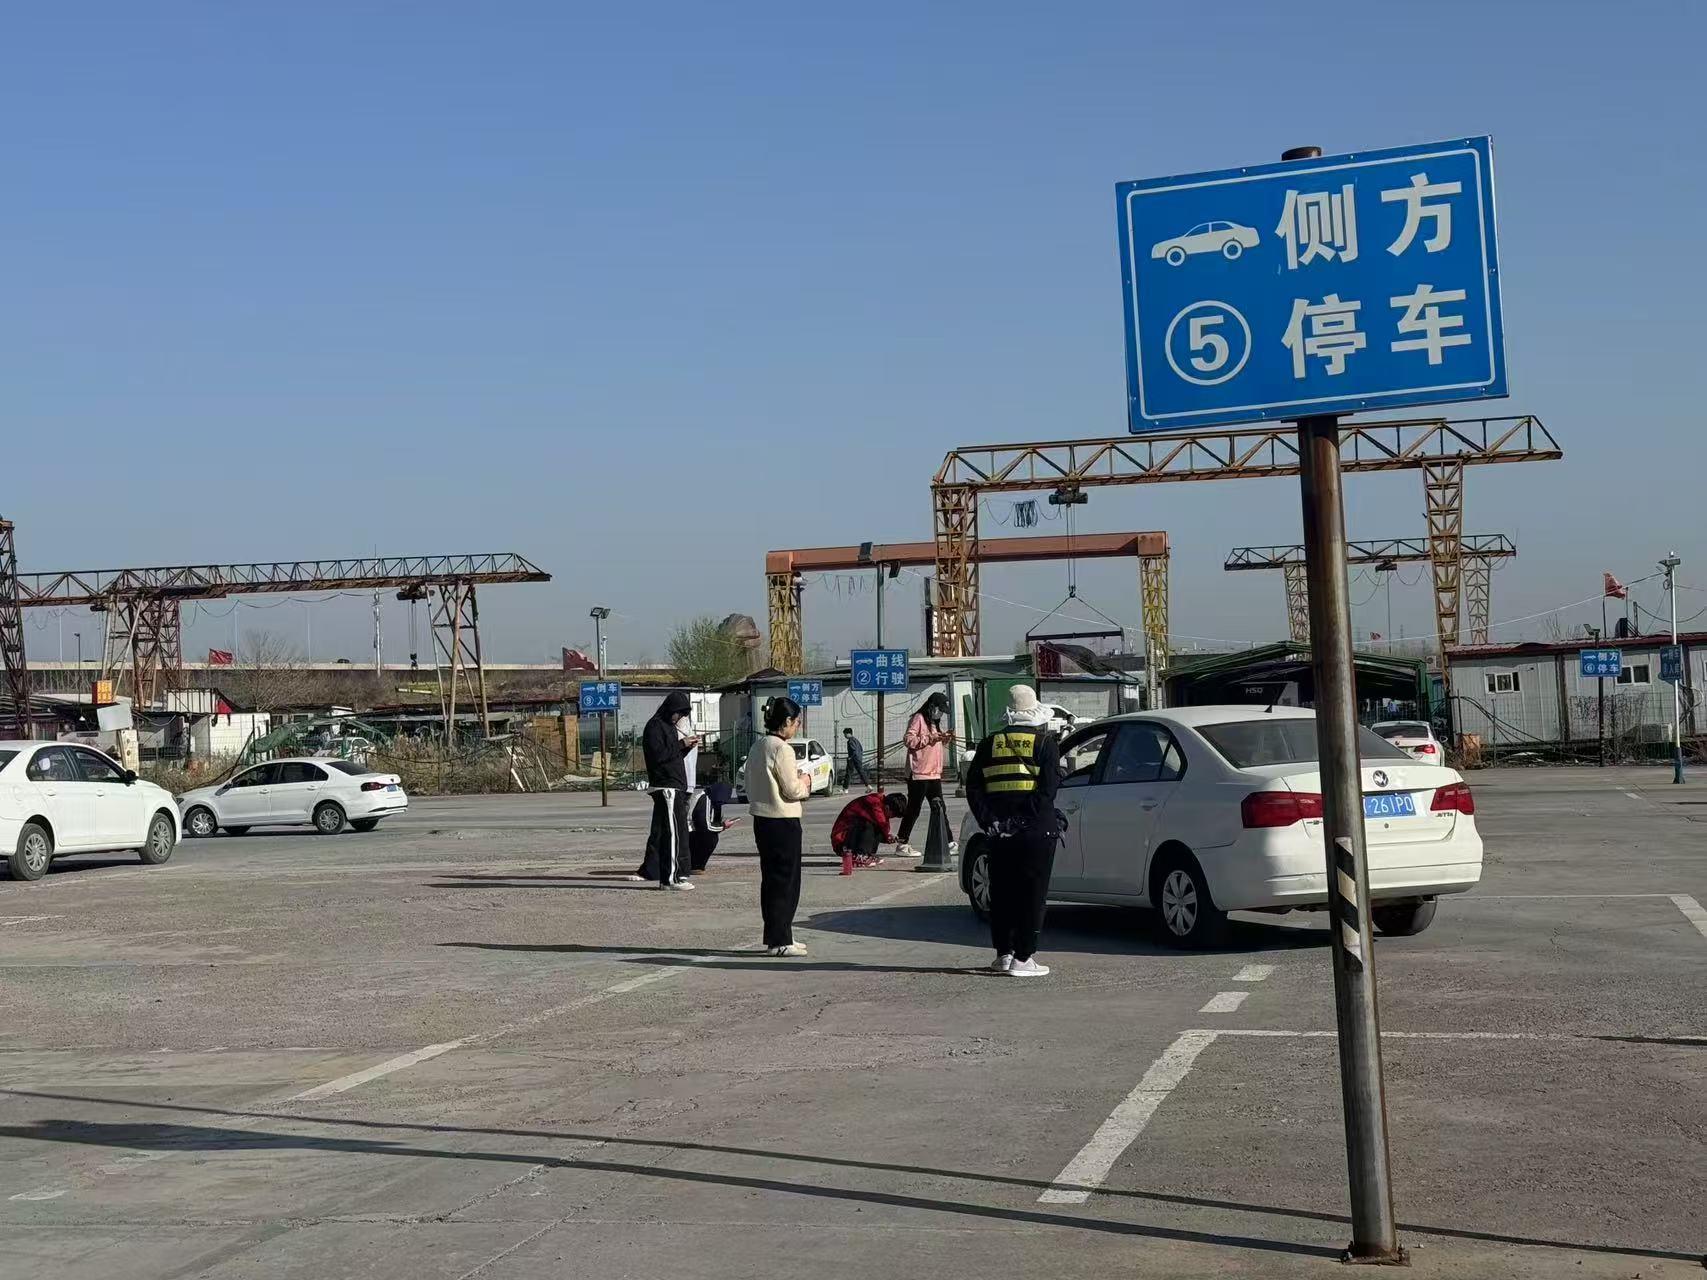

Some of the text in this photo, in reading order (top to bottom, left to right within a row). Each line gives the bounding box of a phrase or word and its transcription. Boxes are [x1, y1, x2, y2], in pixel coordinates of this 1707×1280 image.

[1275, 172, 1462, 270] 侧方
[1281, 284, 1472, 379] 停车
[875, 653, 905, 668] 曲线
[1597, 651, 1619, 661] 侧方
[1597, 663, 1620, 673] 停车
[875, 671, 905, 686] 行驶
[801, 683, 820, 692] 侧方
[597, 696, 618, 706] 入库
[801, 693, 820, 702] 停车
